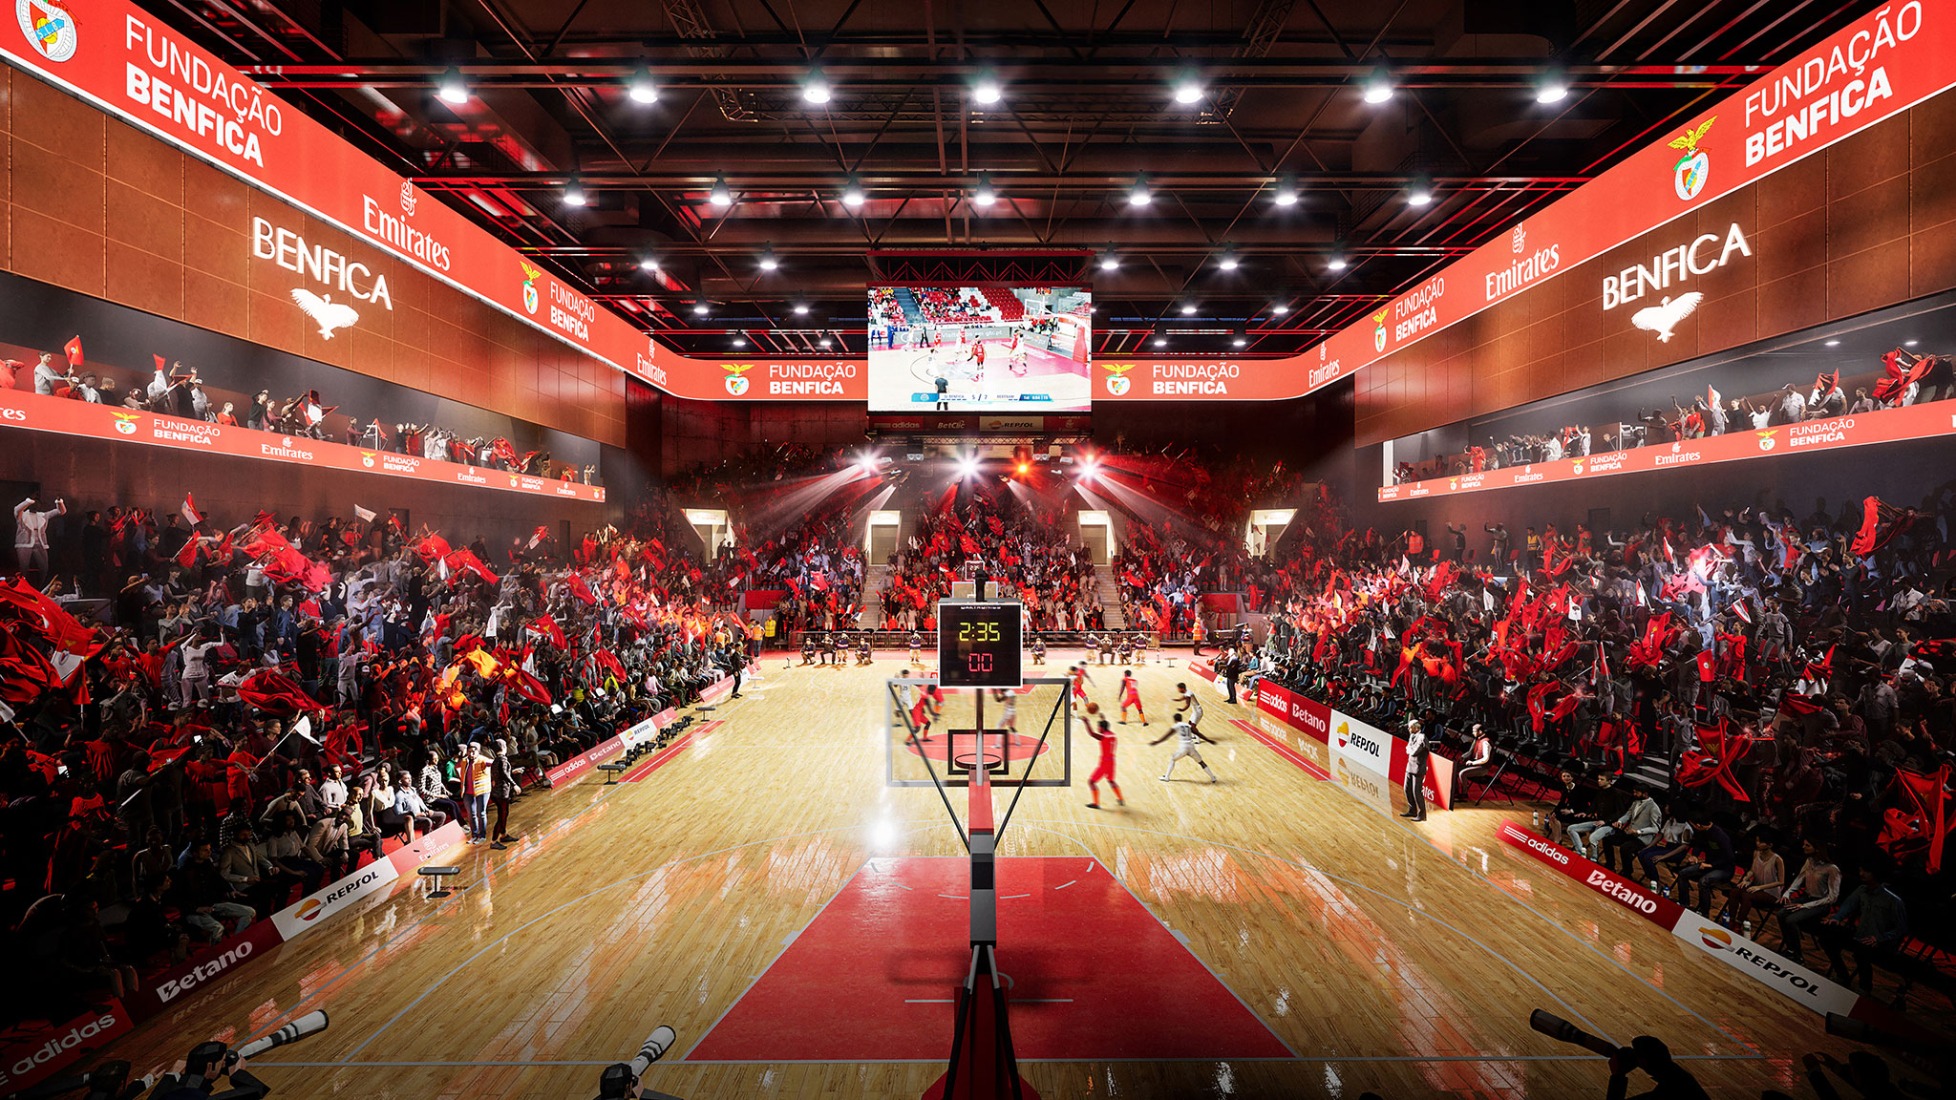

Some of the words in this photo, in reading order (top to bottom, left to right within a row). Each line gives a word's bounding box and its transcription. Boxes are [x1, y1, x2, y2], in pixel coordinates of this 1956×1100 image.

[126, 13, 282, 136] FUNDAÇÃO
[1745, 0, 1922, 128] FUNDAÇÃO
[126, 61, 264, 168] BENFICA
[1745, 66, 1893, 168] BENFICA
[363, 193, 451, 271] Emirates
[253, 216, 393, 311] BENFICA
[1485, 243, 1560, 301] Emirates
[1603, 222, 1752, 311] BENFICA
[551, 281, 595, 323] FUNDAÇÃO
[1395, 276, 1445, 320] FUNDAÇÃO
[551, 305, 589, 342] BENFICA
[1395, 307, 1437, 342] BENFICA
[637, 352, 667, 386] Emirates
[769, 362, 856, 381] FUNDAÇÃO
[1153, 362, 1240, 381] FUNDAÇÃO
[1308, 358, 1340, 388] Emirates
[769, 381, 844, 394] BENFICA
[1153, 381, 1228, 394] BENFICA
[154, 418, 220, 437] FUNDAÇÃO
[892, 421, 920, 429] adidas
[937, 419, 965, 429] BetClic
[1790, 418, 1855, 436] FUNDAÇÃO
[154, 429, 212, 445] BENFICA
[1790, 430, 1846, 447] BENFICA
[261, 443, 313, 460] Emirates
[383, 455, 420, 467] FUNDAÇÃO
[1590, 452, 1628, 465] FUNDAÇÃO
[1655, 450, 1701, 466] Emirates
[383, 462, 415, 472] BENFICA
[1590, 461, 1622, 472] BENFICA
[457, 472, 486, 484] Emirates
[1514, 472, 1543, 483] Emirates
[959, 622, 1000, 641] 2:35
[968, 653, 992, 672] 00
[1269, 693, 1288, 713] adidas
[1292, 702, 1326, 732] Betano
[589, 740, 621, 761] Betano
[1350, 732, 1380, 758] REPSOL
[564, 758, 586, 774] adidas
[1527, 838, 1569, 865] adidas
[326, 871, 379, 904] REPSOL
[1586, 869, 1657, 914] Betano
[156, 941, 253, 1003] Betano
[1734, 947, 1819, 997] REPSOL
[11, 1013, 116, 1075] adidas
